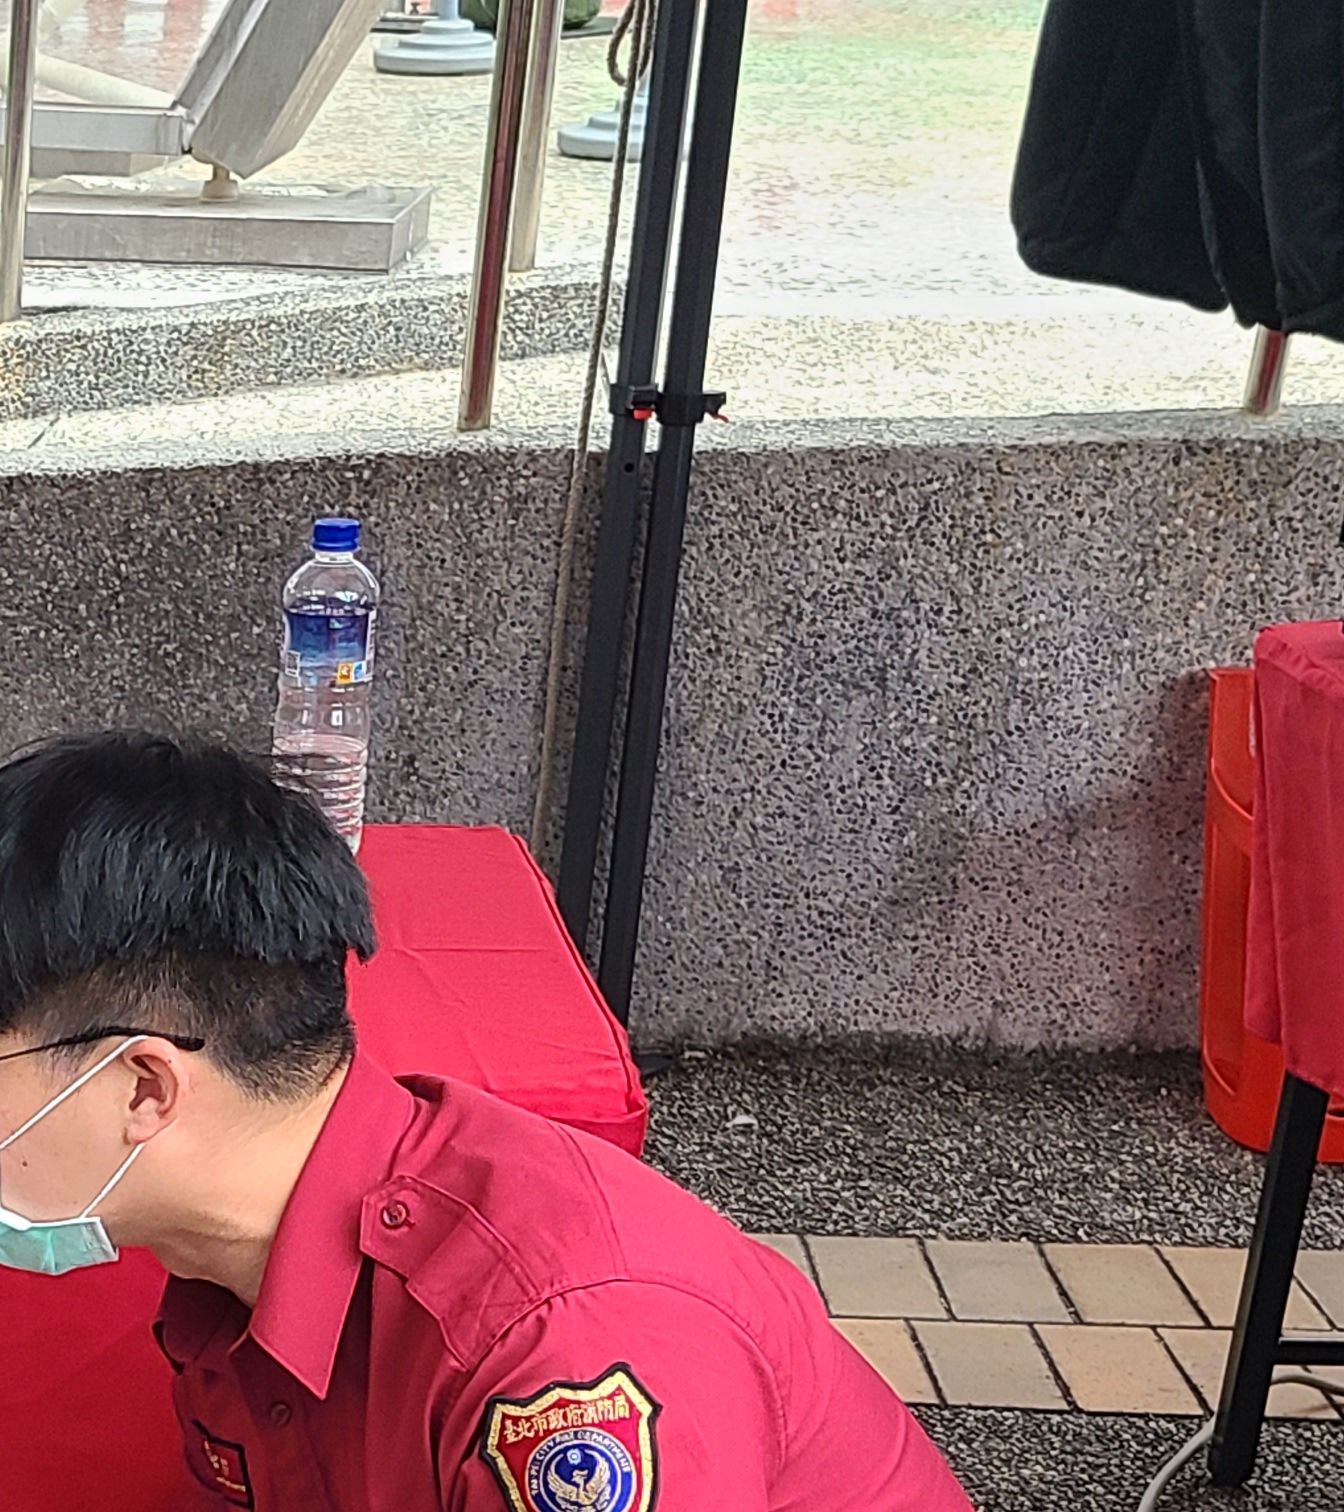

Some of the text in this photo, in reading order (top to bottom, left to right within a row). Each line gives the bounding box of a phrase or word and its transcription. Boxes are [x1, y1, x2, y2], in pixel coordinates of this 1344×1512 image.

[503, 1393, 631, 1444] 臺北市政府消防局
